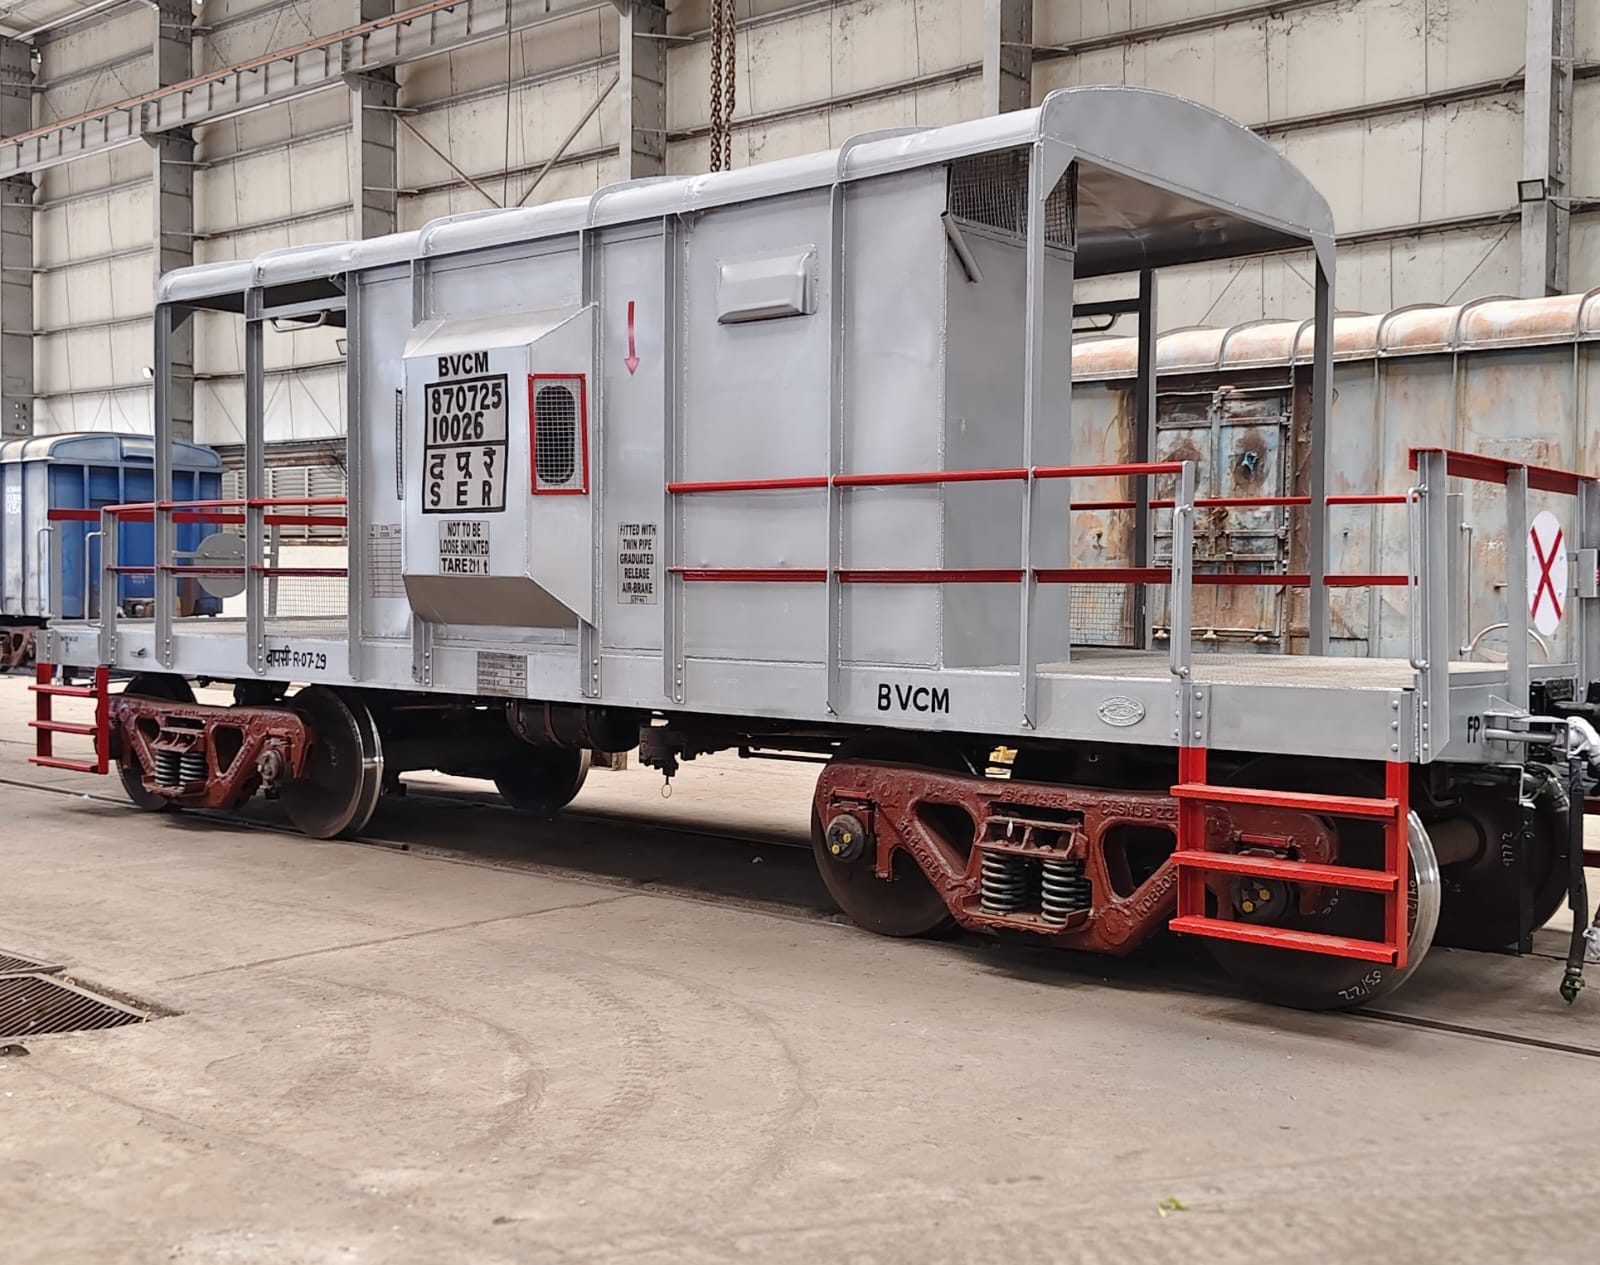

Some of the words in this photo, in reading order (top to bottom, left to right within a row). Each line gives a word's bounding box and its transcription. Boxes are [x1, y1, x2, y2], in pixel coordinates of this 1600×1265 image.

[438, 351, 489, 377] BVCM
[431, 382, 502, 415] 870725
[432, 411, 485, 443] 10026
[447, 522, 461, 537] NOT
[462, 522, 471, 537] TO
[472, 522, 481, 537] BE
[620, 524, 640, 536] FITTED
[641, 524, 656, 536] WITH
[440, 539, 459, 554] LOOSE
[460, 539, 490, 554] SHUNTED
[623, 538, 638, 550] TWIN
[639, 538, 652, 550] PIPE
[441, 557, 468, 573] TARE
[619, 553, 654, 565] GRADUATED
[624, 567, 650, 579] RELEASE
[622, 581, 653, 594] AIR-BRAKE
[877, 683, 949, 713] BVCM
[1467, 715, 1480, 743] FP
